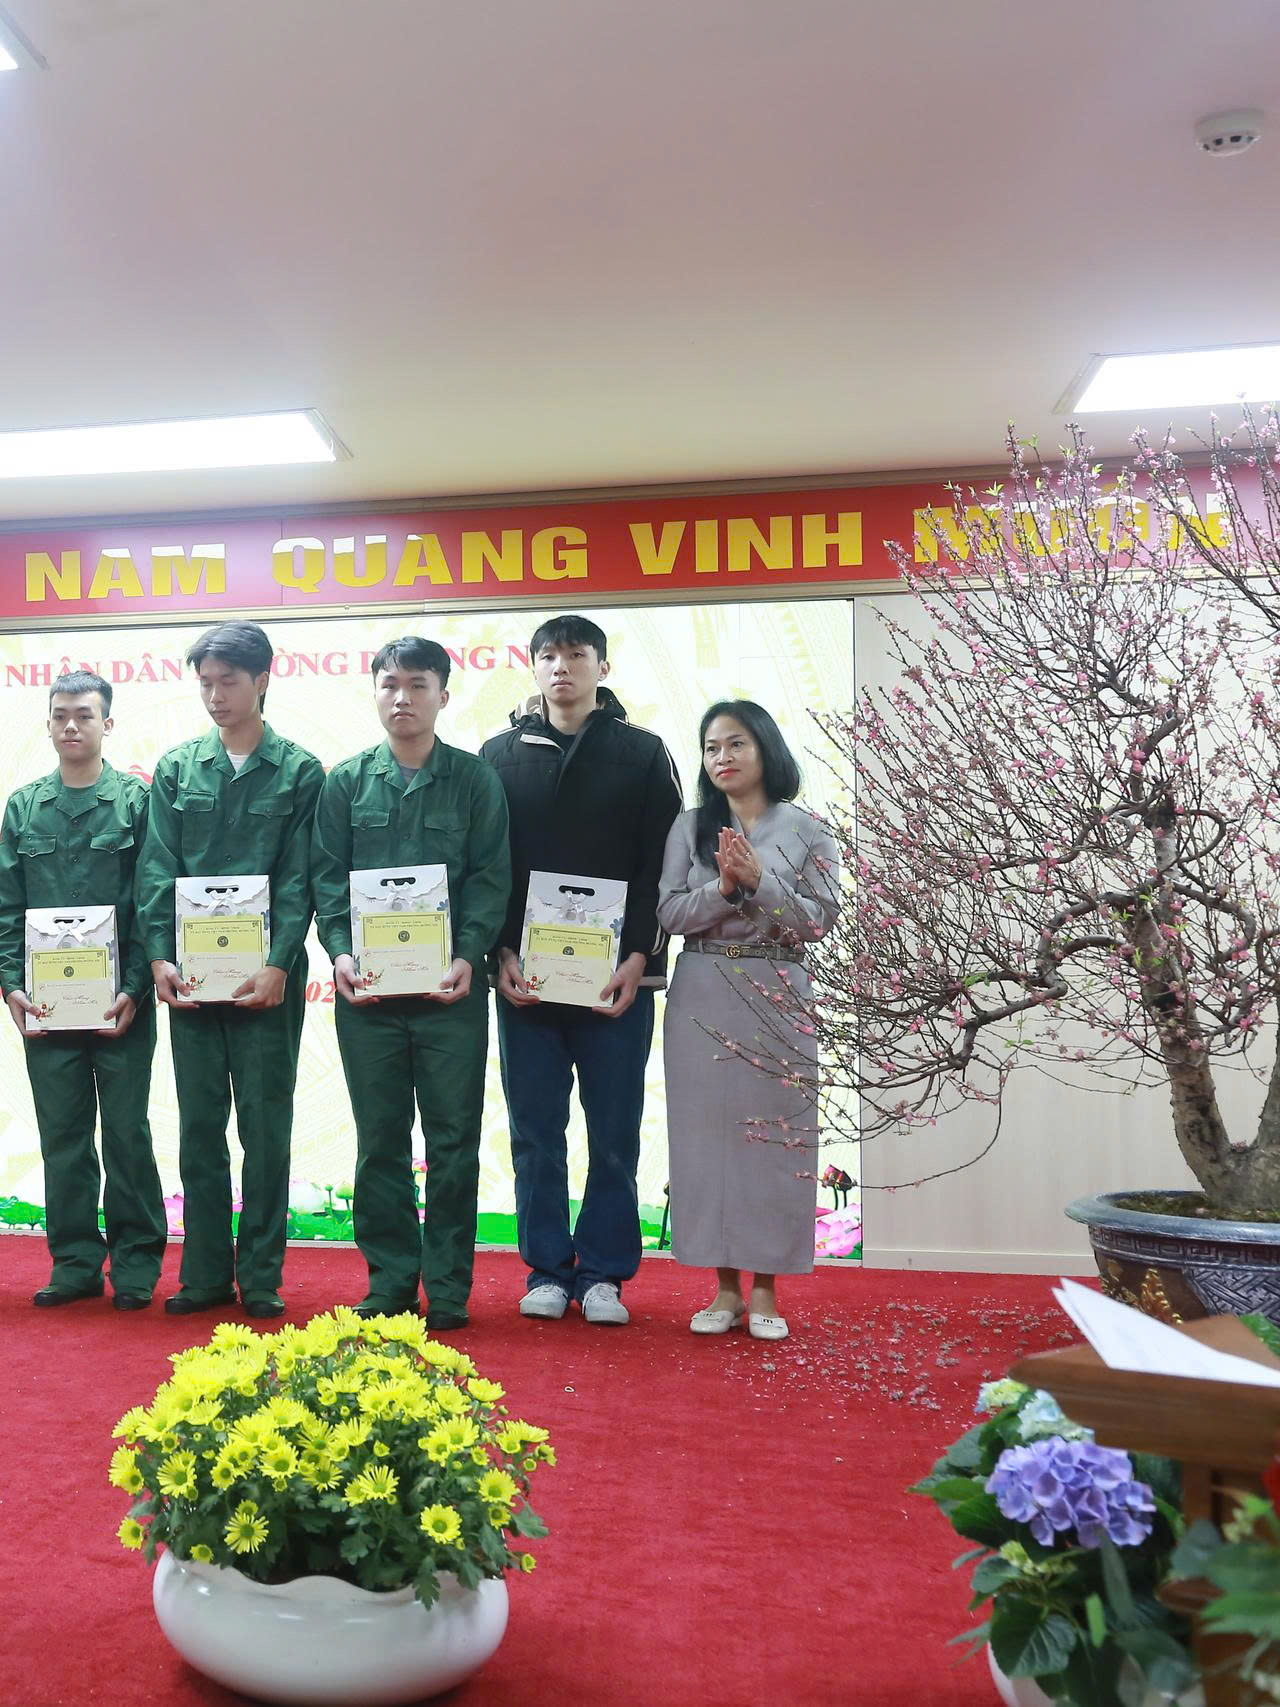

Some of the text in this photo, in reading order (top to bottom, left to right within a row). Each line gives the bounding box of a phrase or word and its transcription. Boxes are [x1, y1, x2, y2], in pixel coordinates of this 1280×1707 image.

[24, 543, 227, 602] NAM
[270, 526, 589, 593] QUANG
[630, 512, 864, 576] VINH
[111, 652, 184, 684] DÂN
